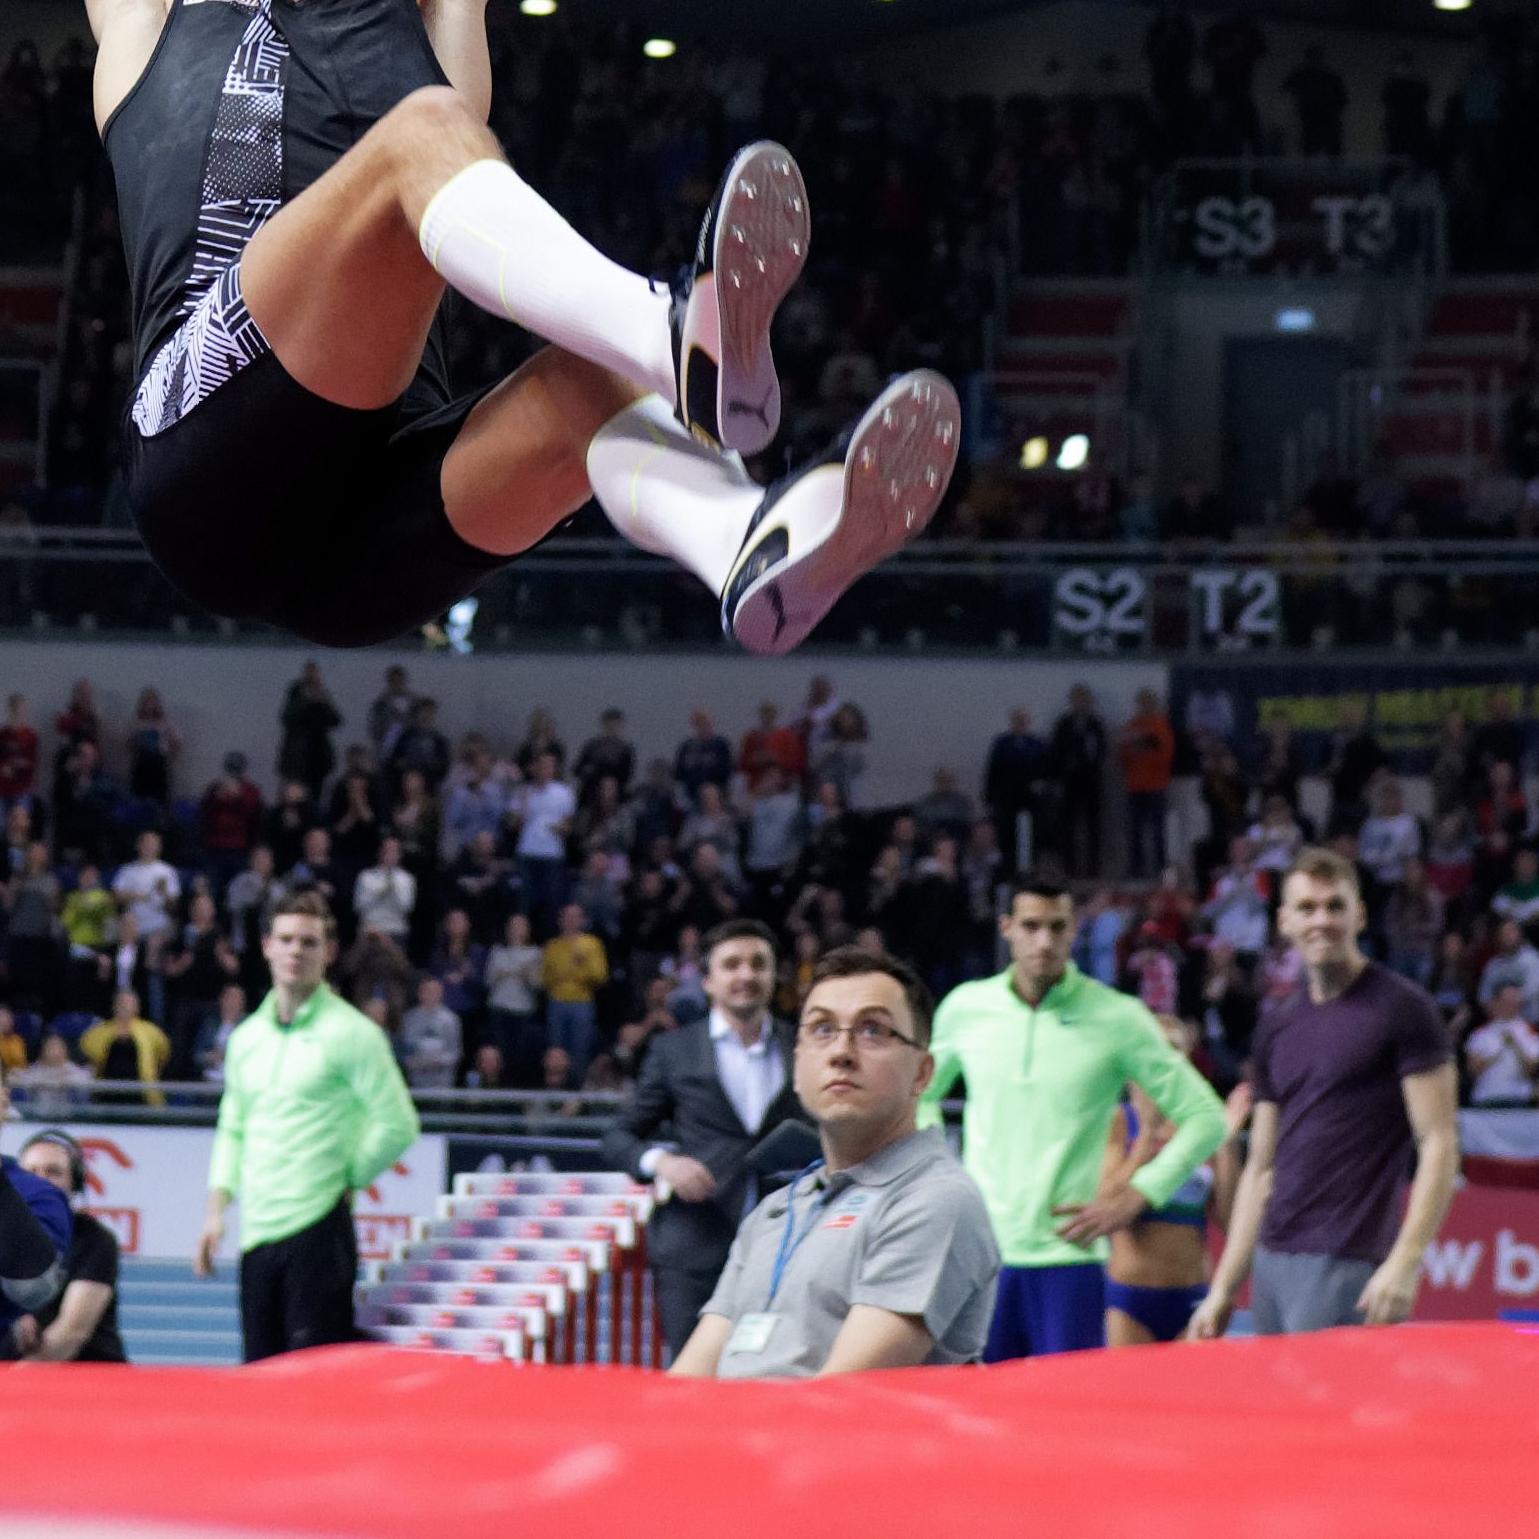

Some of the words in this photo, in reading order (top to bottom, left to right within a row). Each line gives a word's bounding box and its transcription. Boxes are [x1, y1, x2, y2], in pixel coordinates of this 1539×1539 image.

[1194, 196, 1276, 258] S3
[1316, 194, 1397, 254] T3
[1055, 567, 1146, 636] S2
[1192, 569, 1279, 634] T2
